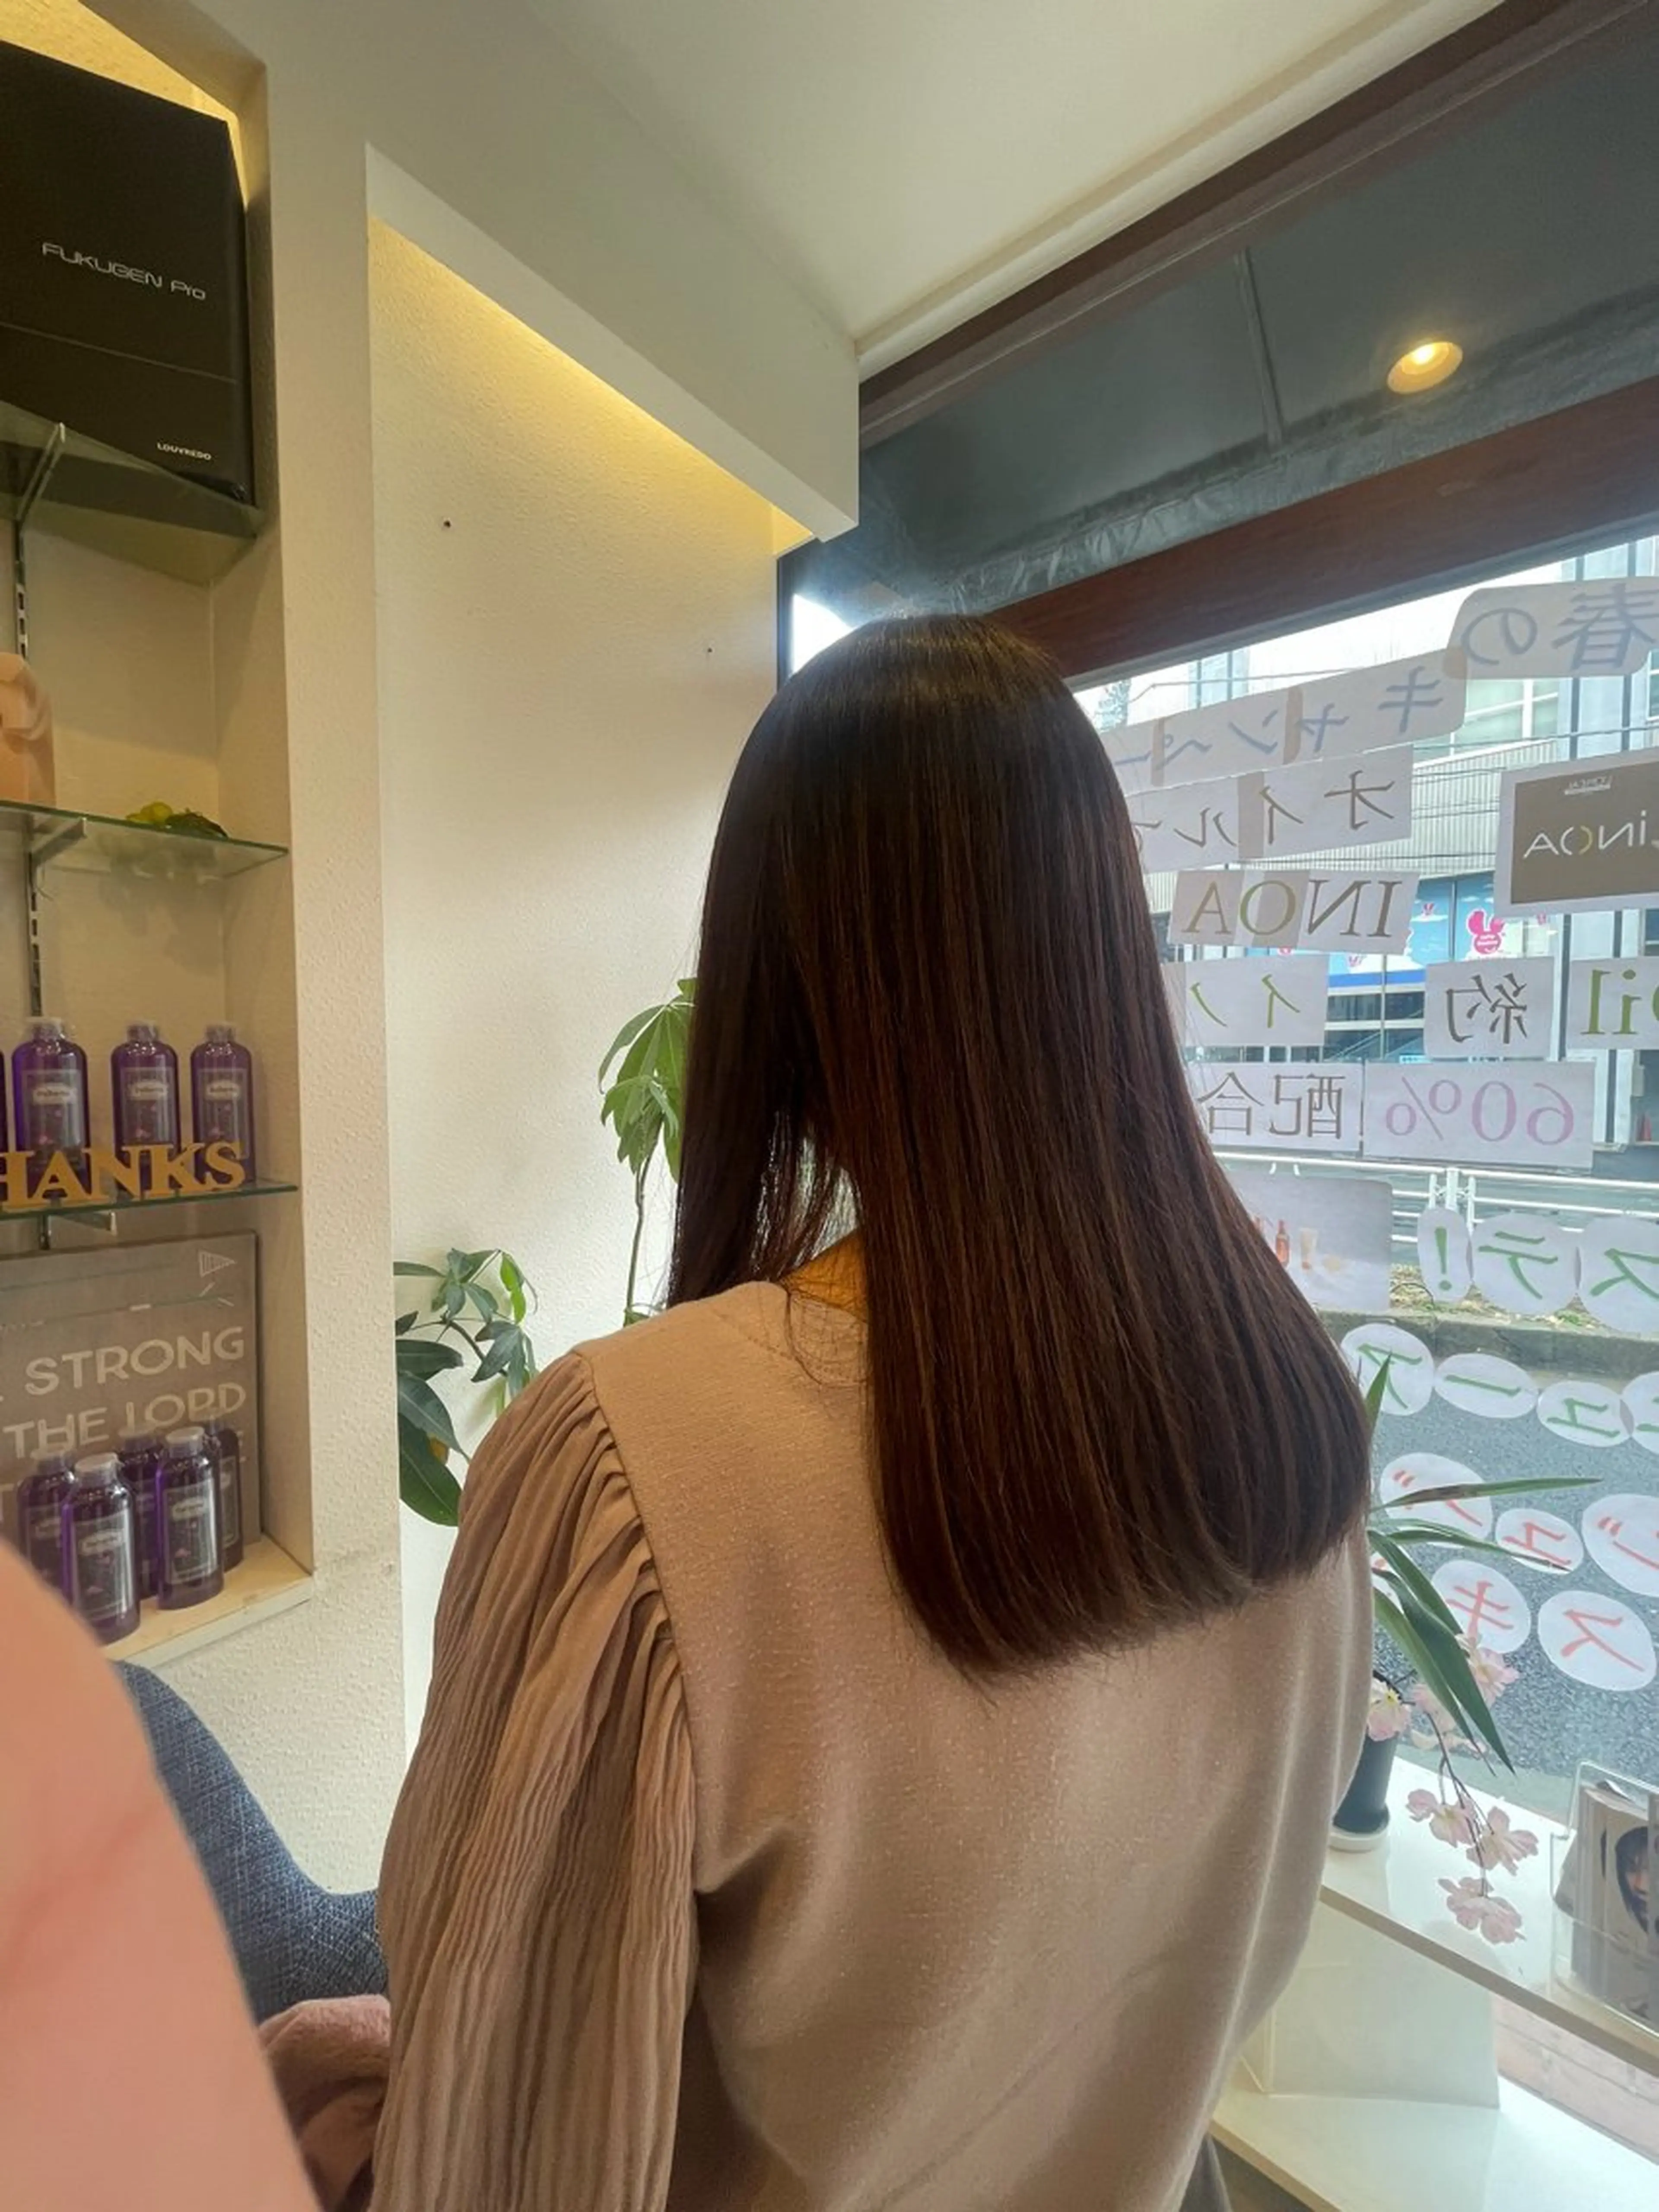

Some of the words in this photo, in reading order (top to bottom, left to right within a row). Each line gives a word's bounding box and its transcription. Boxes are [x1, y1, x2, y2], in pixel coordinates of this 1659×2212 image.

[42, 242, 162, 288] FUKUGEN
[170, 280, 206, 300] Pro
[24, 1326, 245, 1395] STRONG
[3, 1407, 110, 1459] THE
